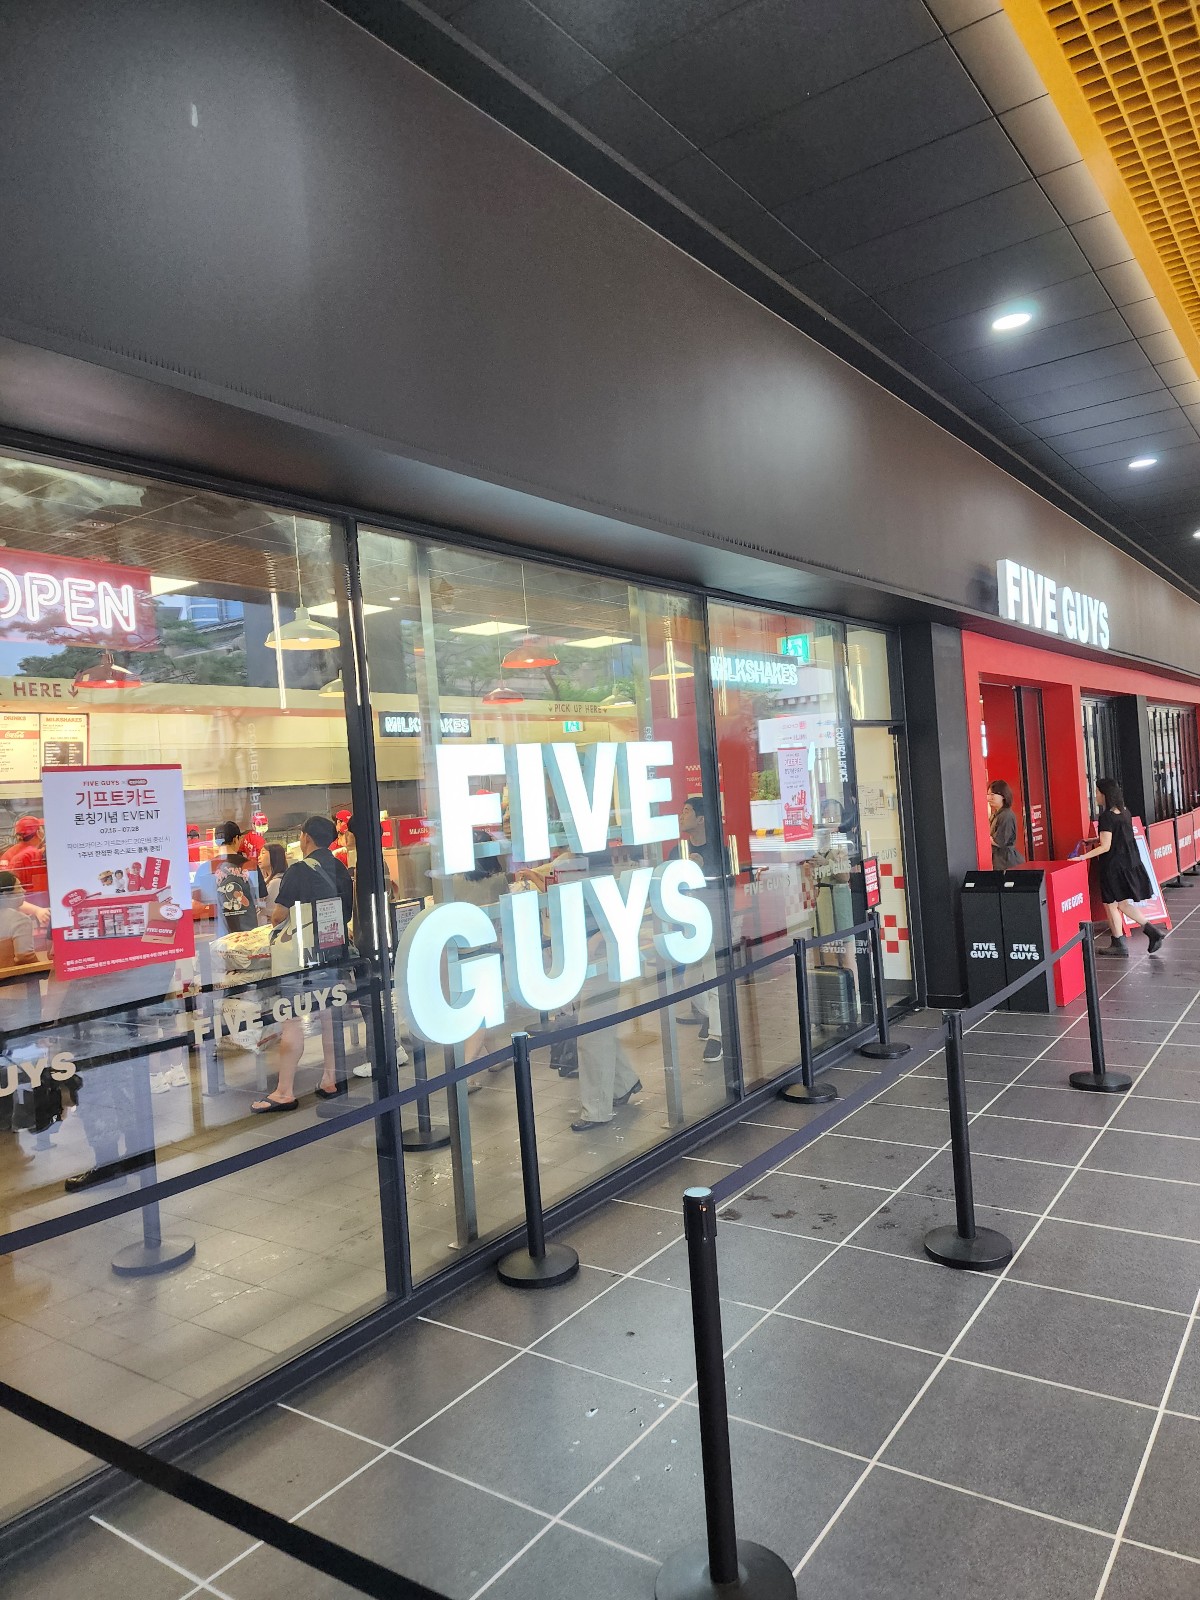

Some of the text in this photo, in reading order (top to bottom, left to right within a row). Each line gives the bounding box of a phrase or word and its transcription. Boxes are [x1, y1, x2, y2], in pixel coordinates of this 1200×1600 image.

[996, 558, 1110, 649] FIVE GUYS
[13, 681, 62, 697] HERE
[554, 704, 602, 713] PICK UP HERE
[384, 716, 469, 734] MILKAKES
[75, 788, 158, 809] 기프트카드
[435, 740, 681, 875] FIVE
[74, 809, 160, 826] 론칭기념 EVENT
[394, 859, 713, 1045] GUYS
[970, 950, 999, 959] GUYS
[972, 942, 997, 951] FIVE
[1012, 943, 1037, 952] FIVE
[1009, 951, 1040, 960] GUYS
[193, 983, 348, 1047] FIVE GUYS
